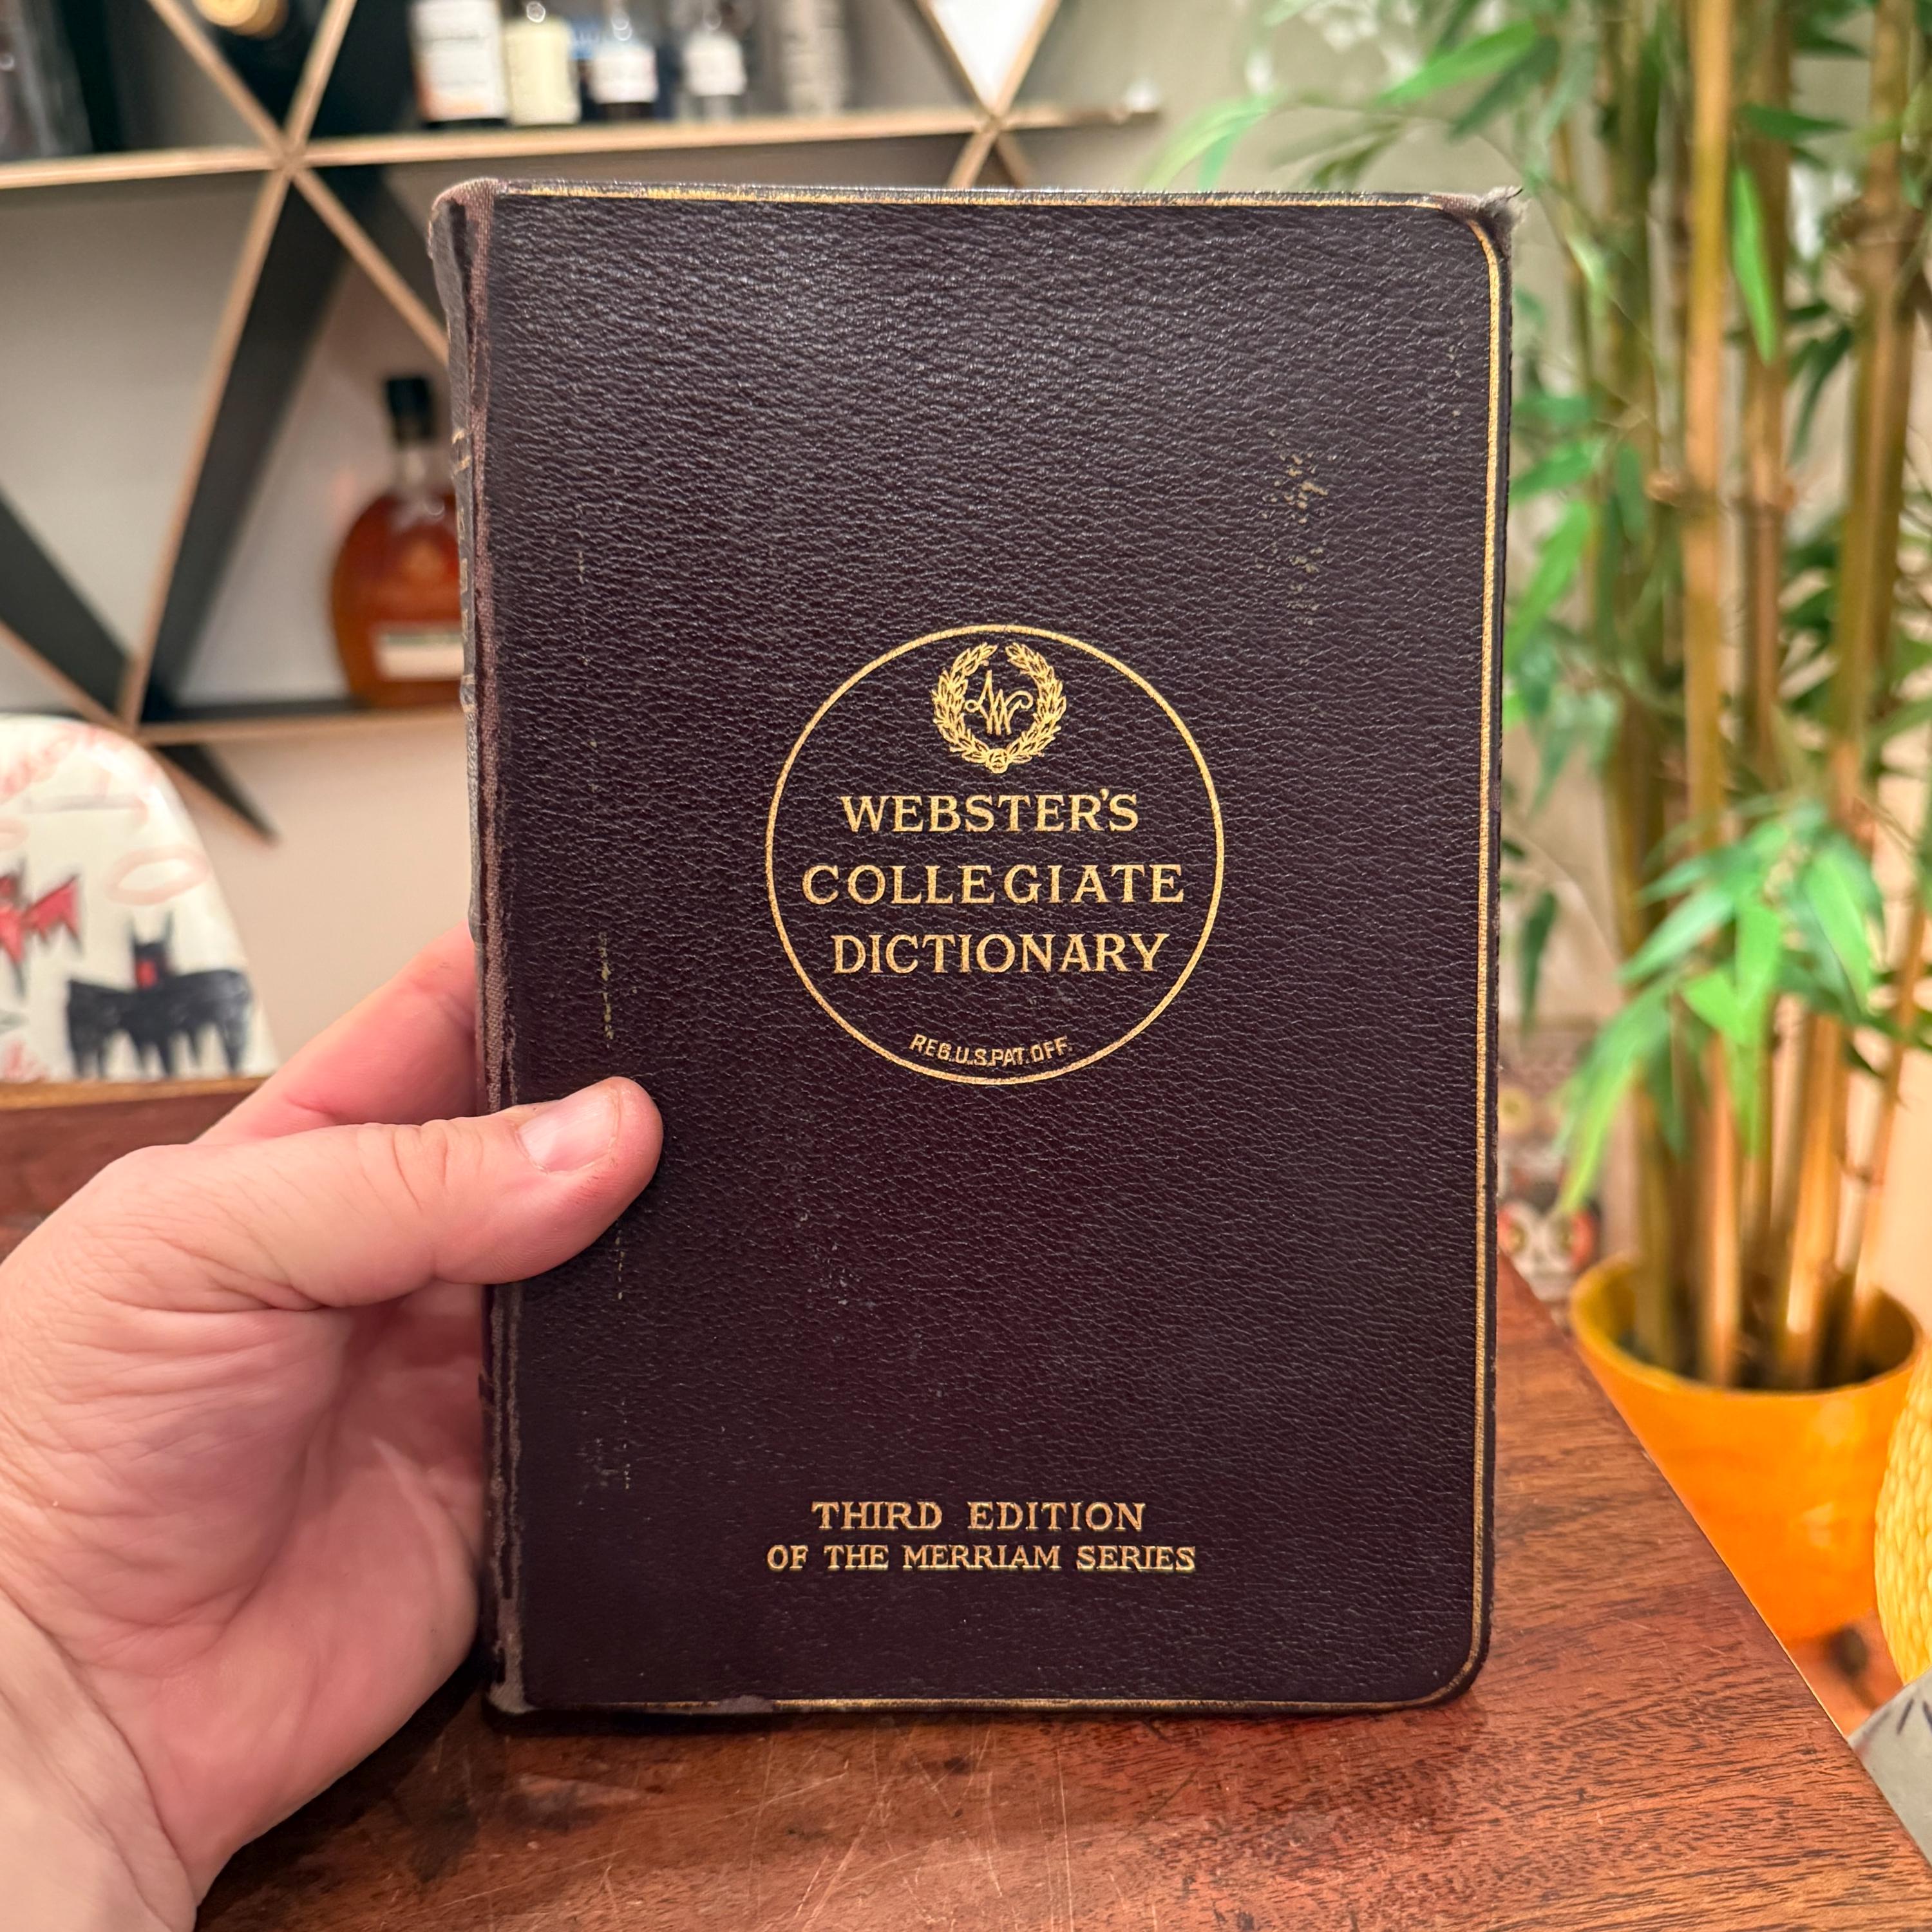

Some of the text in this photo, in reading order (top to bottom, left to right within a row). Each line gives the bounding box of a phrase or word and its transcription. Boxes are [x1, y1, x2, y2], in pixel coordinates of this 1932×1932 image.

[839, 788, 1139, 833] WEBSTER'S
[802, 864, 1184, 905] COLLEGIATE
[831, 933, 1168, 974] DICTIONARY
[811, 1501, 1146, 1531] THIRD EDITION
[766, 1544, 1197, 1573] OF THE MERRIAM SERIES
